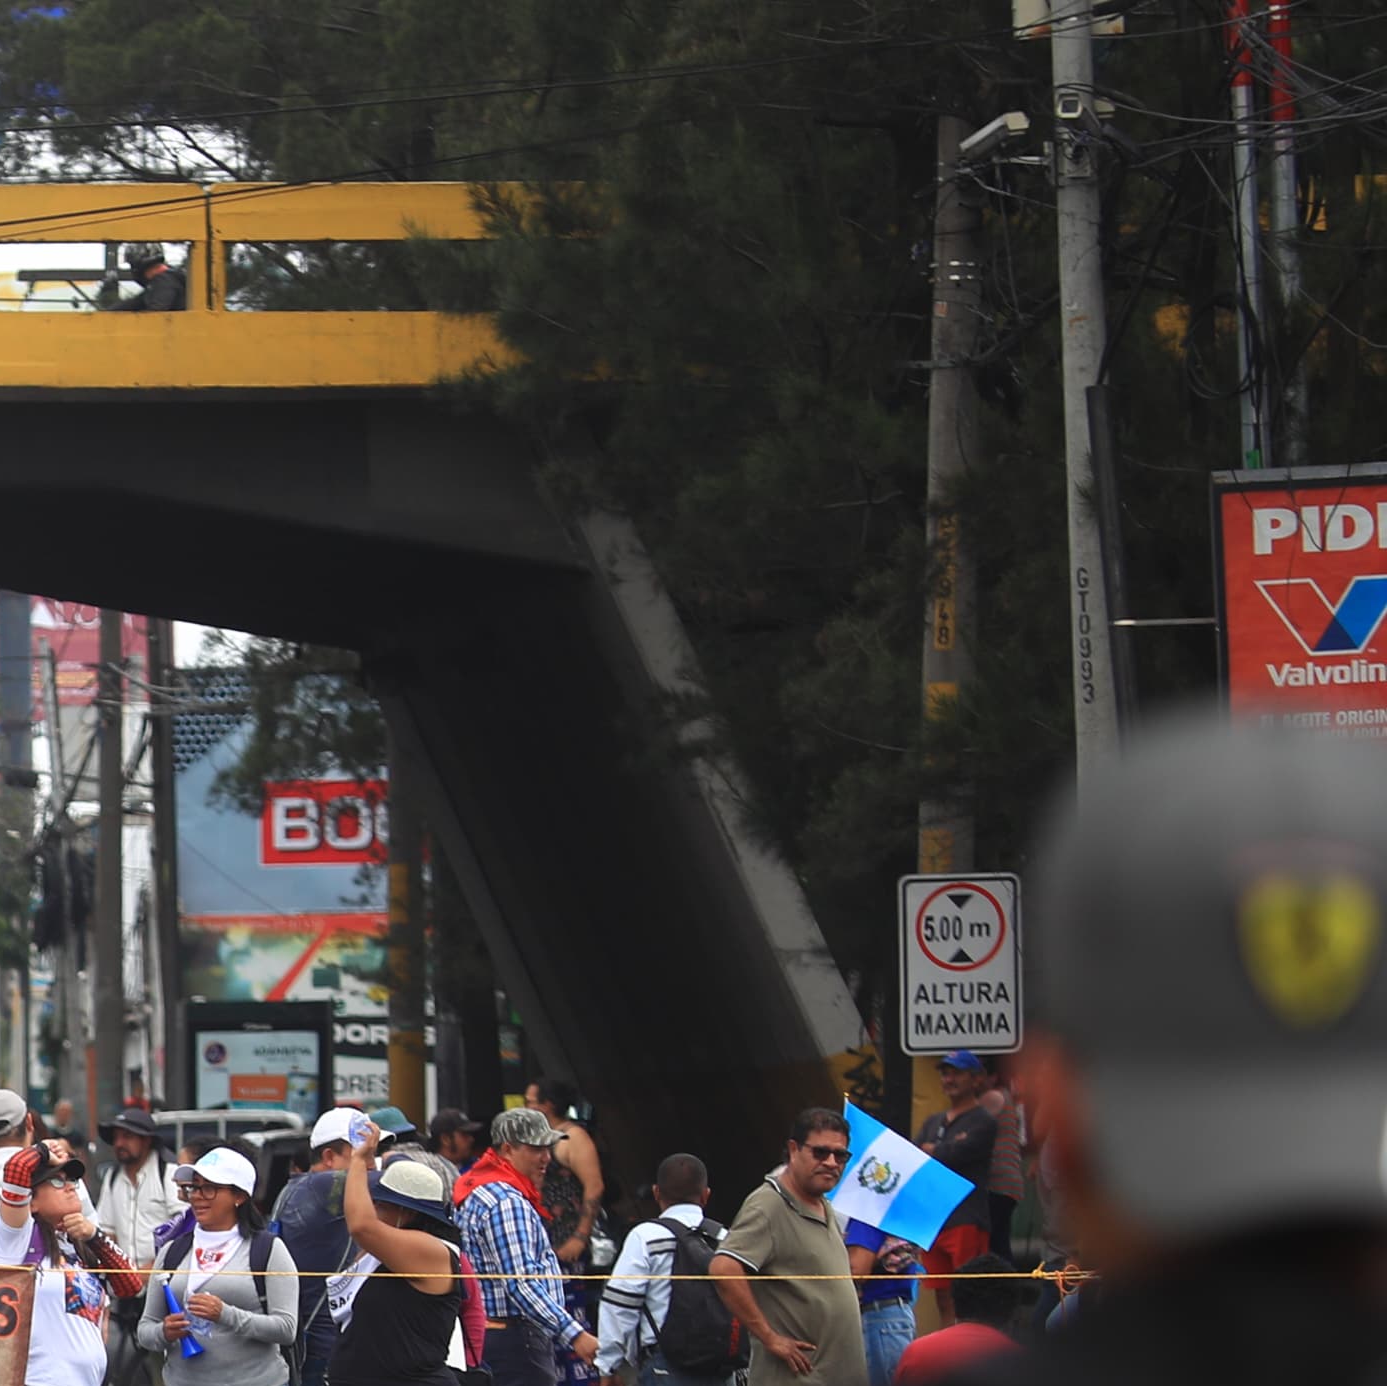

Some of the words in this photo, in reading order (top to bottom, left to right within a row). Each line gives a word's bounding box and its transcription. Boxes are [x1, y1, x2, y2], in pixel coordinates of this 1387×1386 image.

[1253, 502, 1387, 555] PID
[924, 915, 963, 942] 5.00
[969, 921, 991, 937] m
[914, 982, 1011, 1005] ALTURA
[914, 1012, 1012, 1035] MAXIMA
